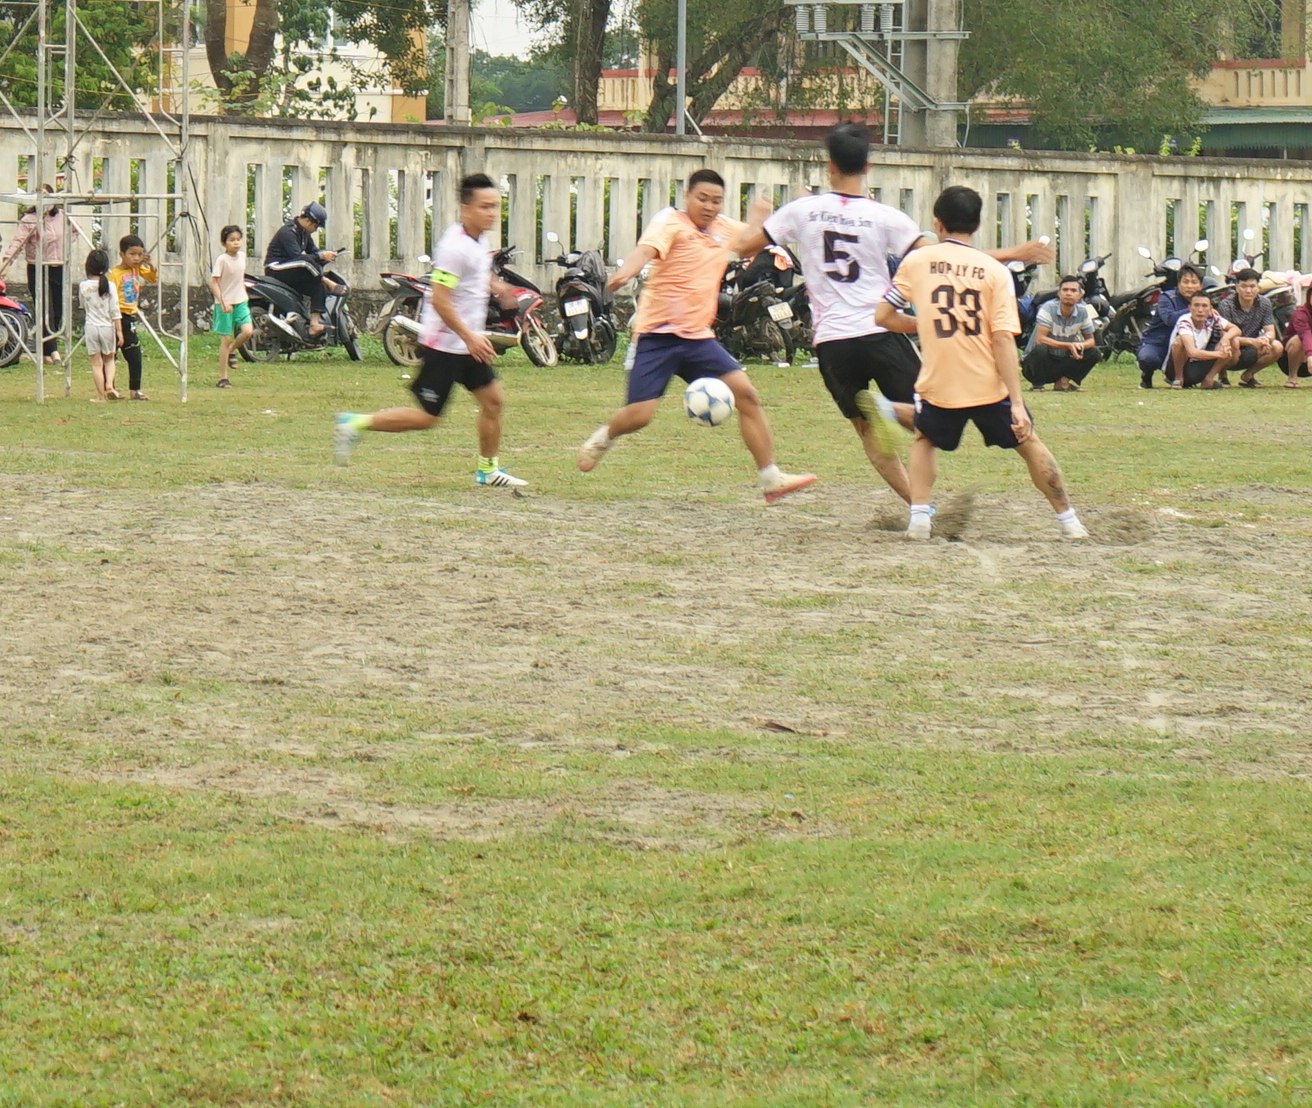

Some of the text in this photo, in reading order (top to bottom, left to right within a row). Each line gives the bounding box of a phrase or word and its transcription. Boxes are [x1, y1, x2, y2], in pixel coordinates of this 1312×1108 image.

[824, 230, 860, 283] 5
[971, 266, 985, 280] FC
[931, 284, 982, 339] 33
